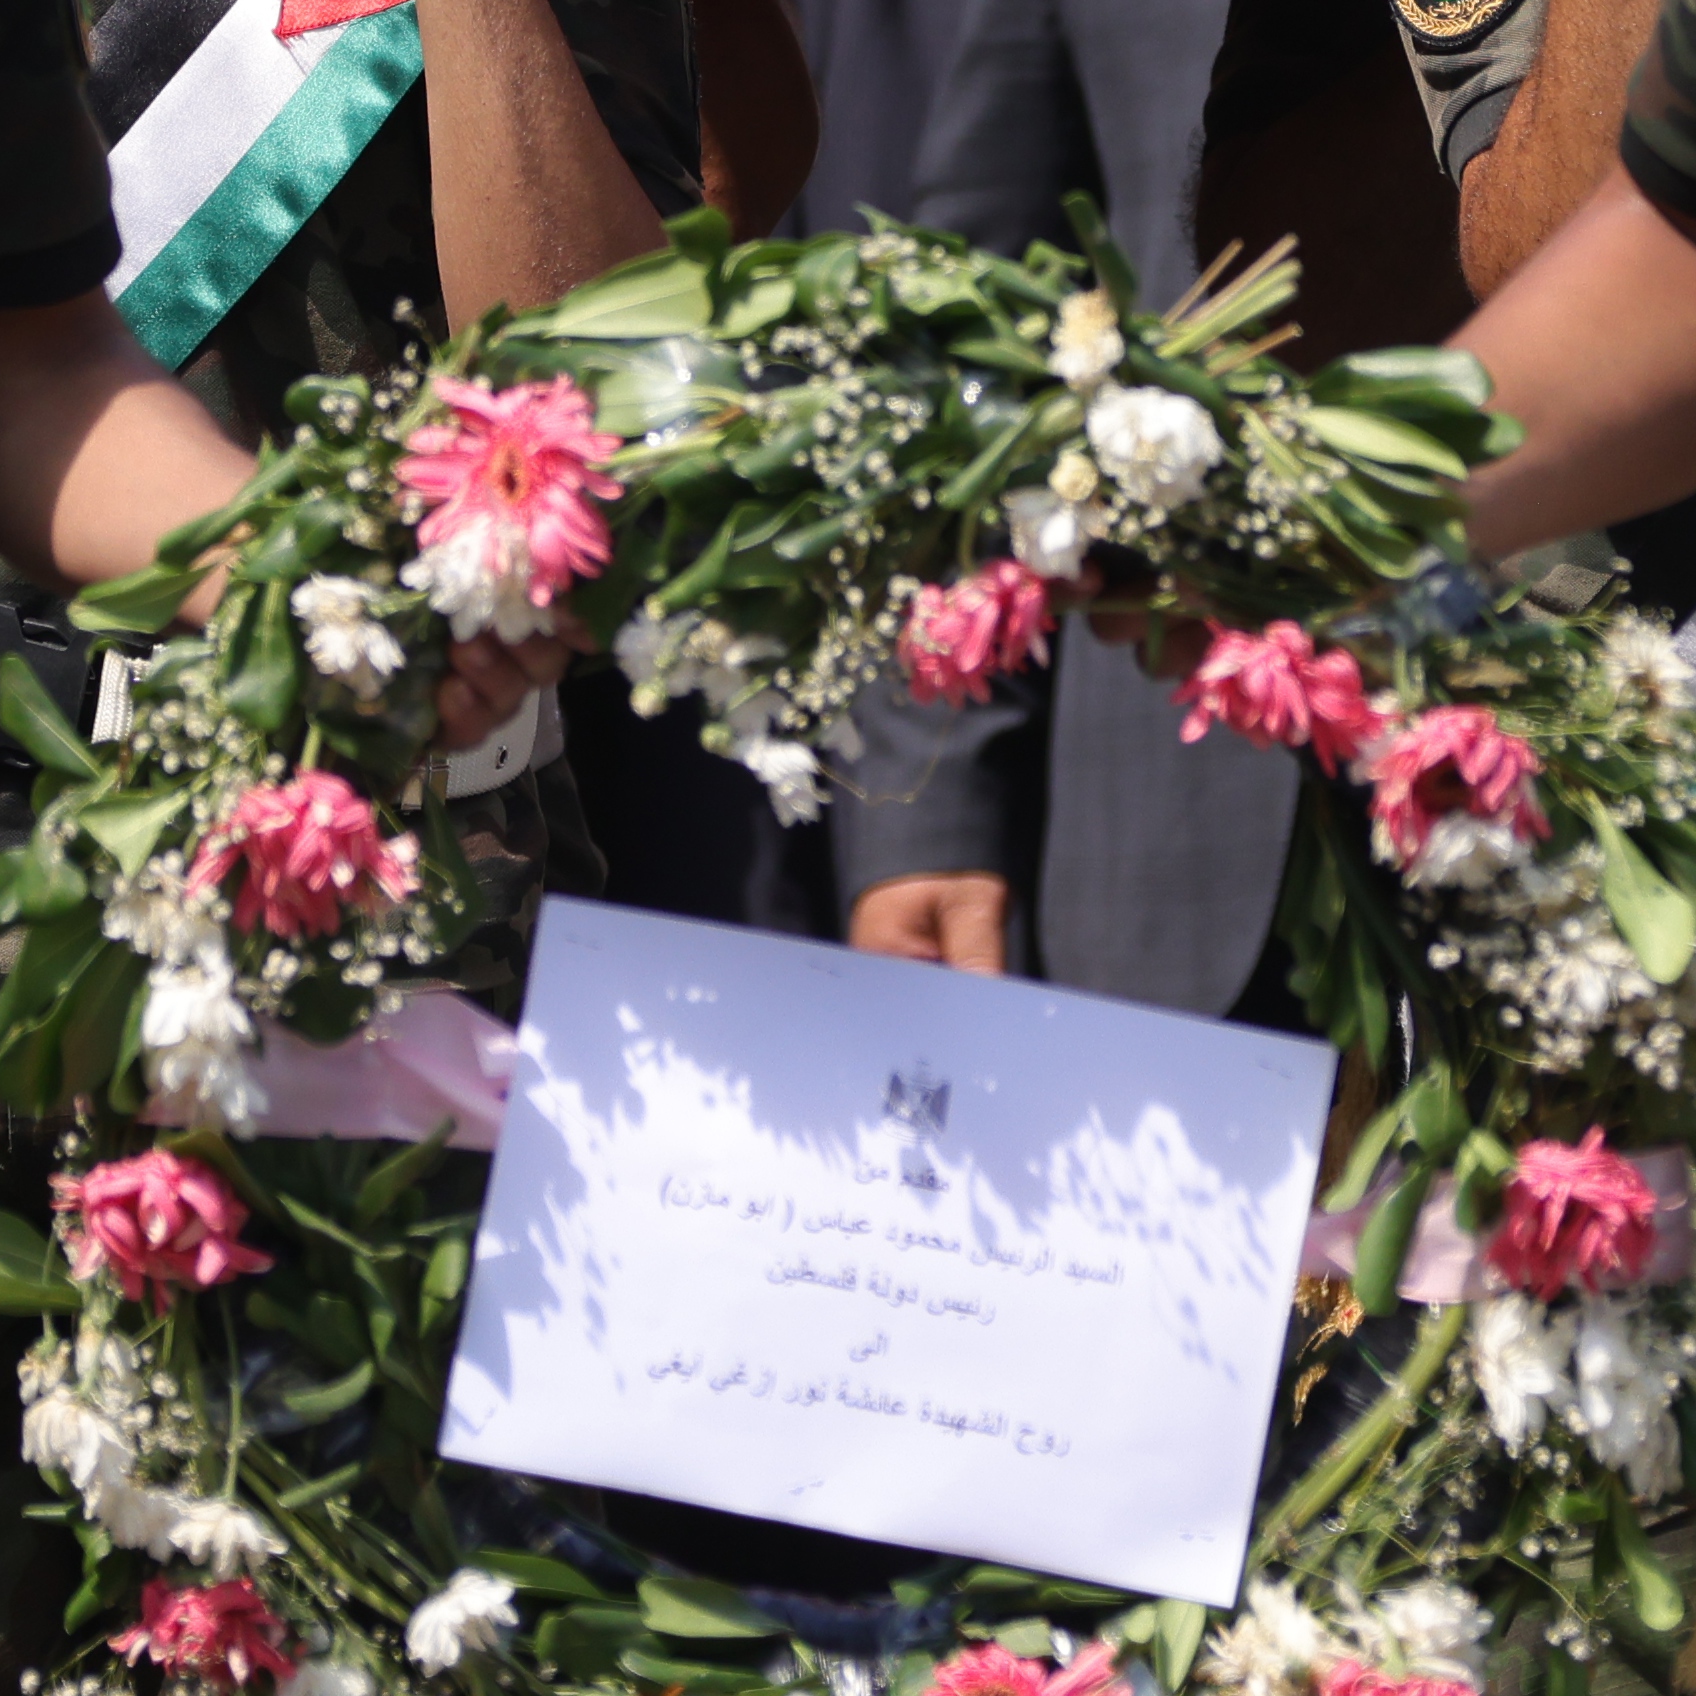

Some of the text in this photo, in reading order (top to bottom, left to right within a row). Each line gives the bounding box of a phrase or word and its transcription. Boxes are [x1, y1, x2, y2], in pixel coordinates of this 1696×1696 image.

[855, 1161, 889, 1184] من
[802, 1208, 874, 1241] عباس
[885, 1226, 962, 1253] محمود
[968, 1244, 1055, 1276] الرئيس
[1063, 1256, 1125, 1286] السيد
[765, 1253, 996, 1325] رئيس دولة فلسطين
[782, 1379, 828, 1408] نور
[836, 1377, 907, 1416] عائشة
[917, 1399, 1010, 1438] الشهيدة
[1013, 1422, 1072, 1458] روح
